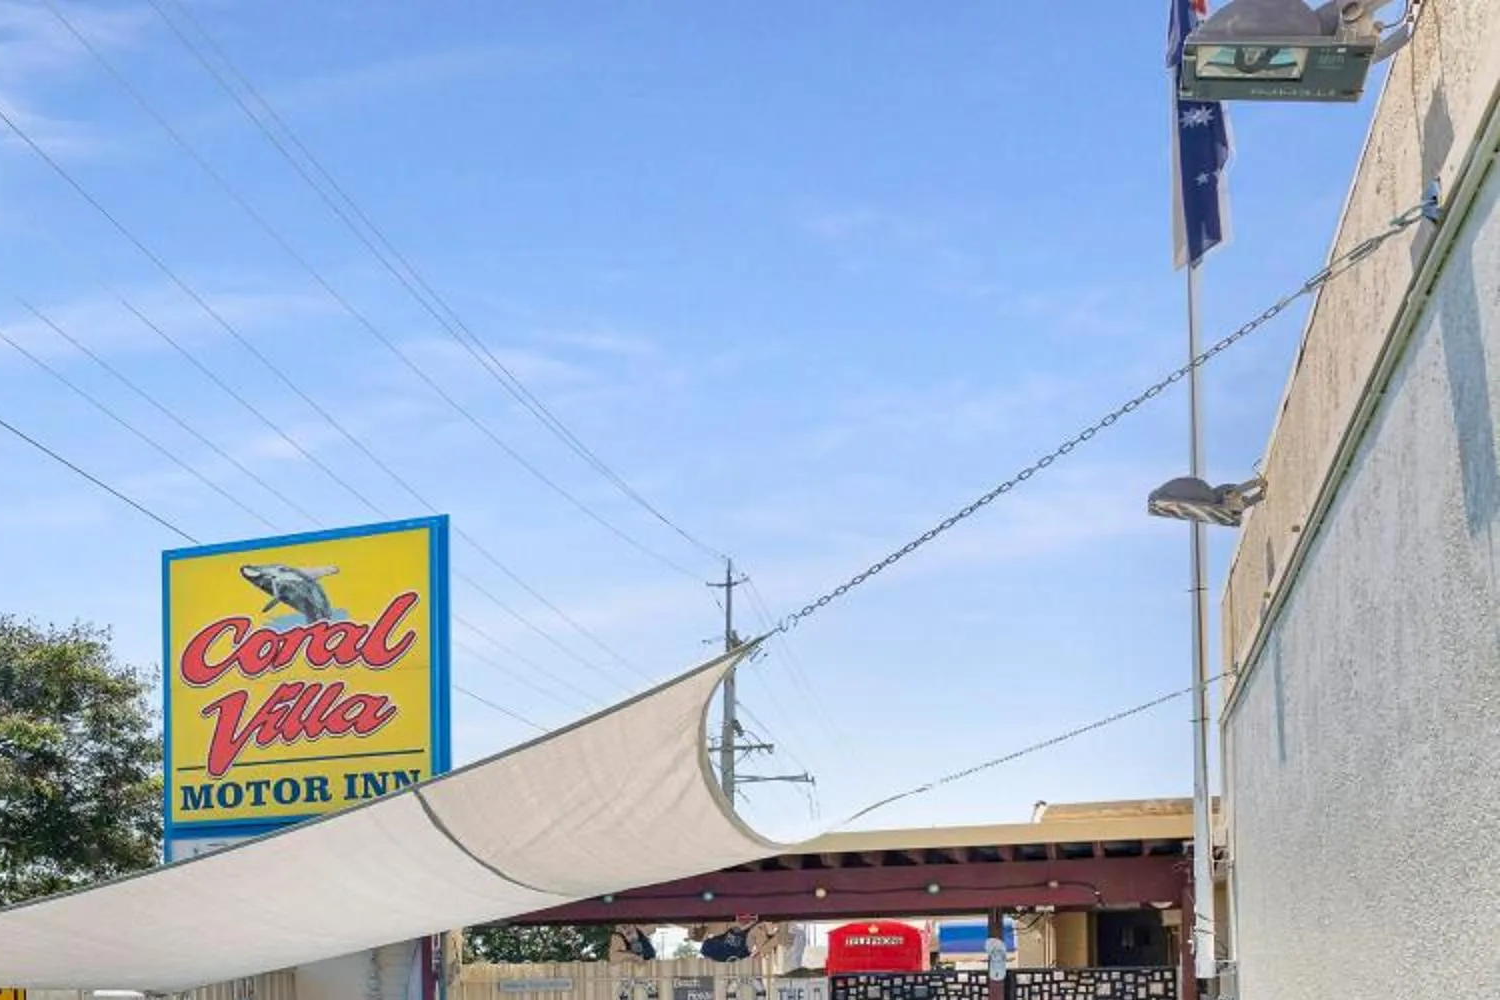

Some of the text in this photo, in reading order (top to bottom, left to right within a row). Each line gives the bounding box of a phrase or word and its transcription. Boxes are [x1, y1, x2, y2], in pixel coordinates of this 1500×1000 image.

[180, 591, 420, 687] Coral
[200, 681, 398, 779] Villa
[180, 776, 333, 811] MOTOR
